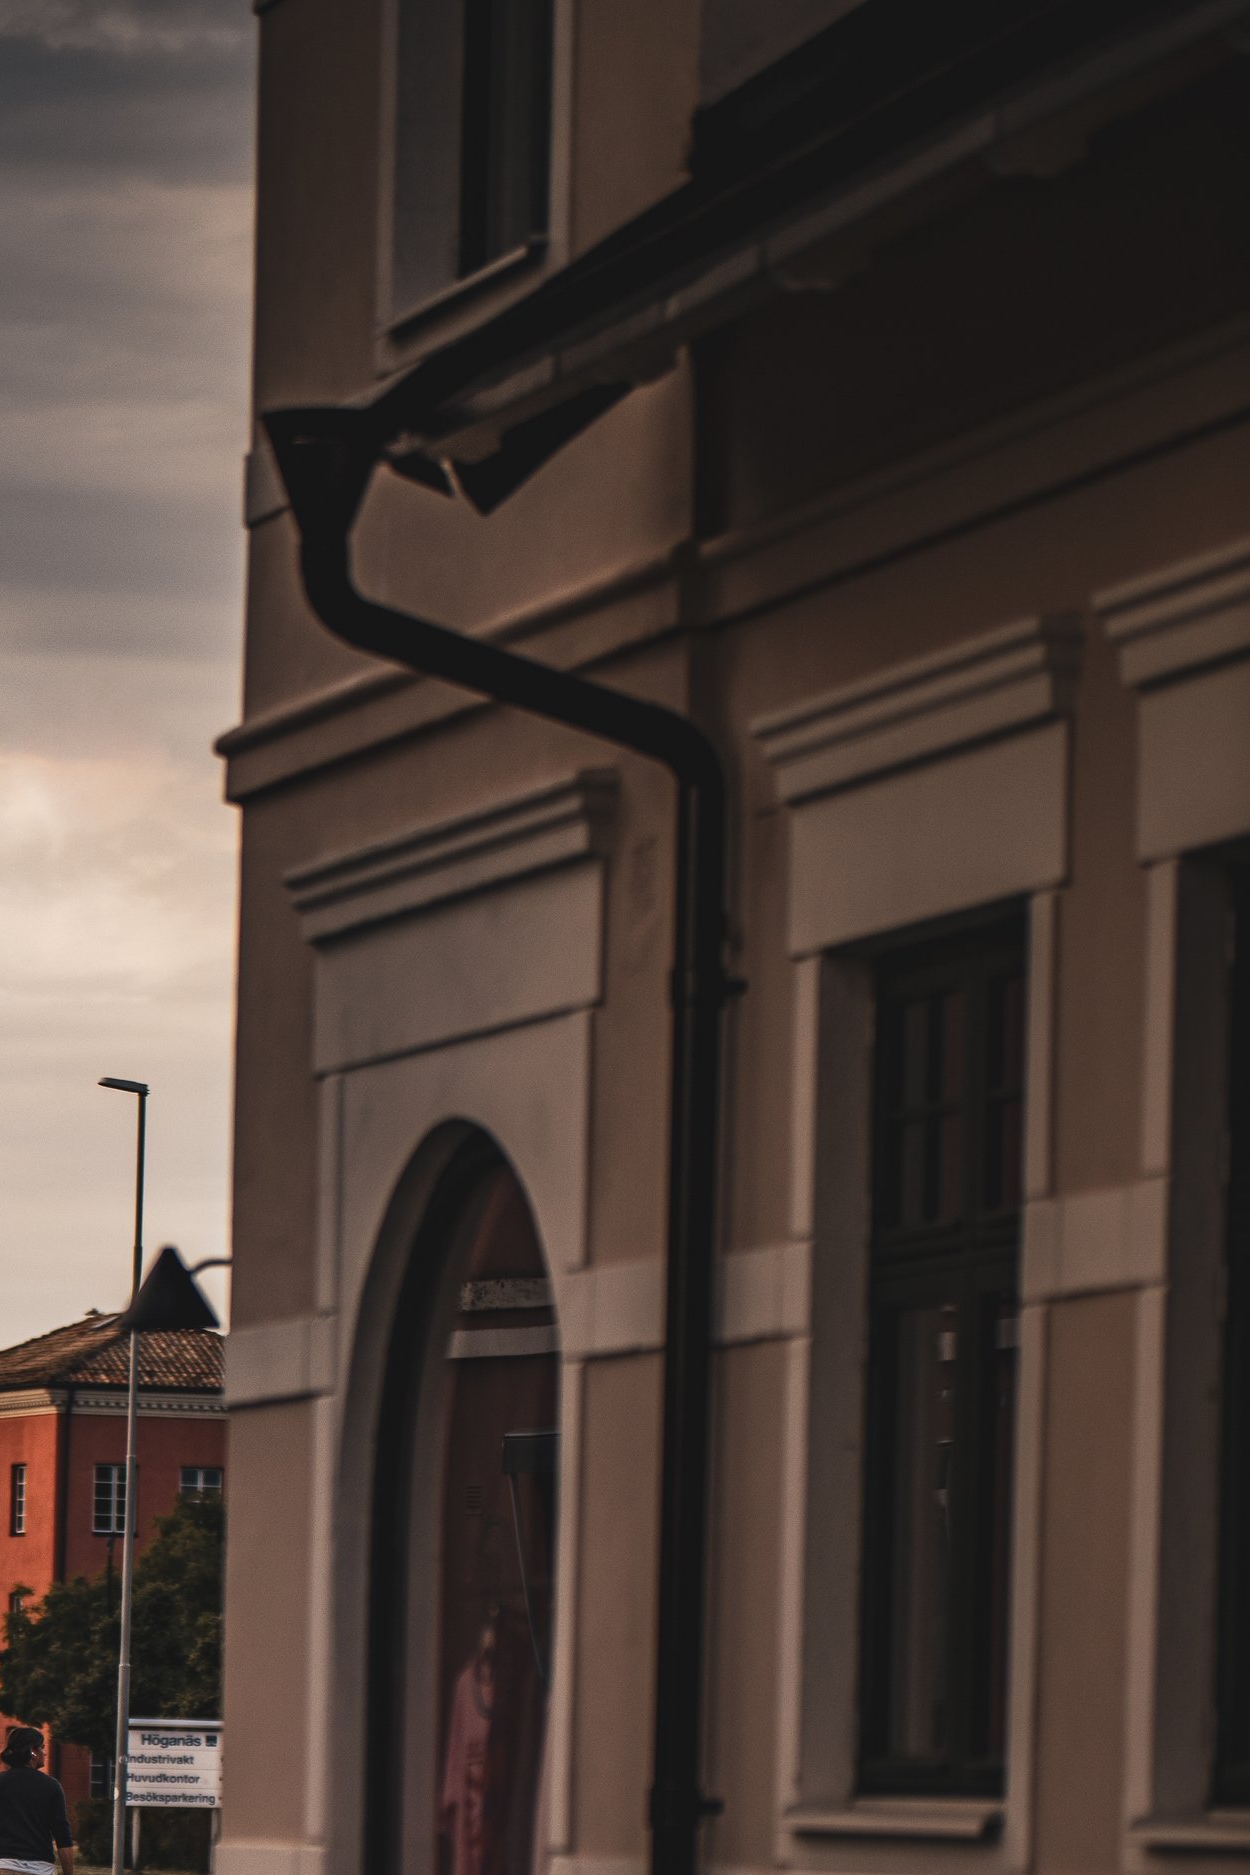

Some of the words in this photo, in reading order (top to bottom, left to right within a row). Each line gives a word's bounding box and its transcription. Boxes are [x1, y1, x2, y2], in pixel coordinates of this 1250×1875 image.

[141, 1733, 201, 1748] Höganäs
[126, 1773, 200, 1784] Huvudkontor
[126, 1791, 215, 1805] Besöksparkering
